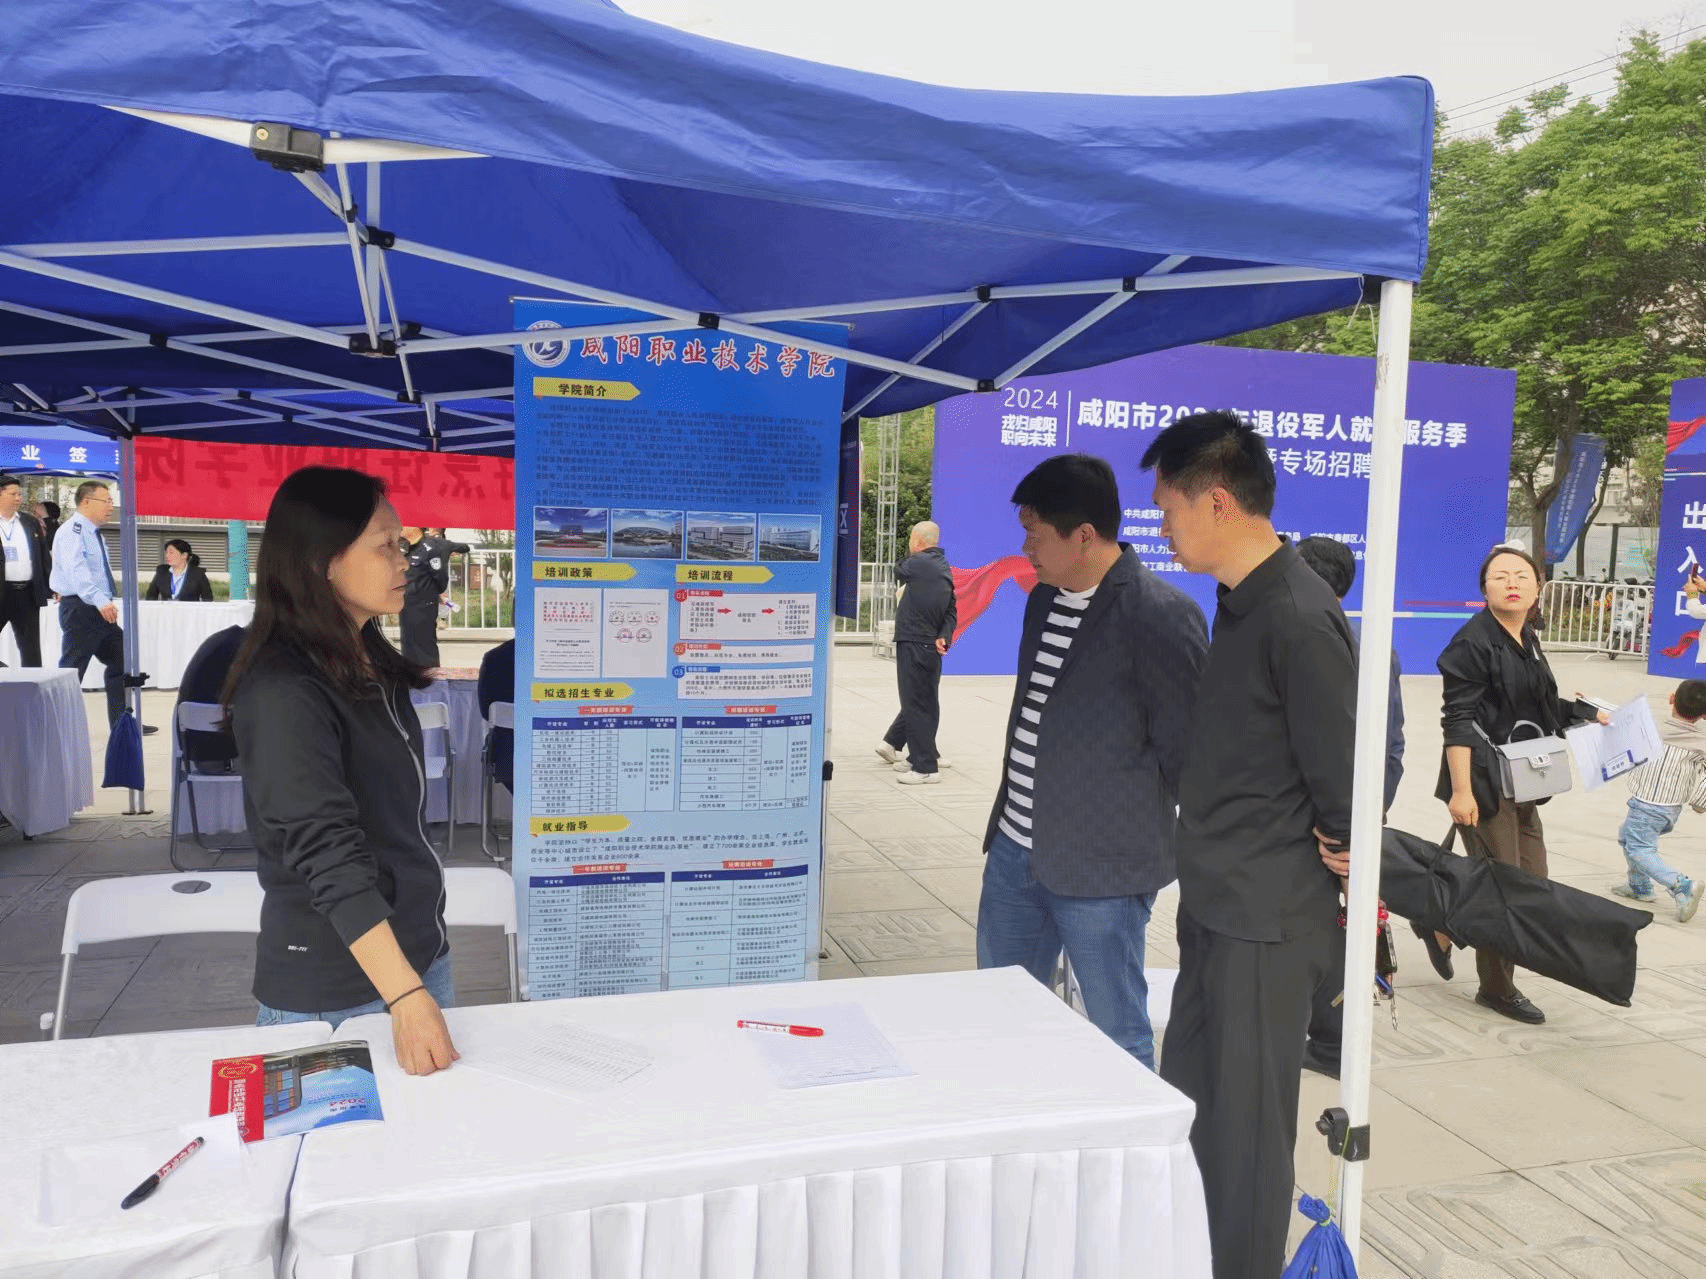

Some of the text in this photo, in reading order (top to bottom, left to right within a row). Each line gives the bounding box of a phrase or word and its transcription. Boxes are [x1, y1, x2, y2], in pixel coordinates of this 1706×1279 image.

[580, 334, 835, 377] 咸阳职业技术学院
[558, 383, 608, 397] 学院简介
[1004, 387, 1058, 409] 2024
[1001, 429, 1056, 447] 职向未来
[545, 567, 593, 578] 培训政策
[688, 570, 733, 581] 培训流程
[544, 688, 614, 699] 拟选招生专业
[542, 820, 588, 832] 就业指导
